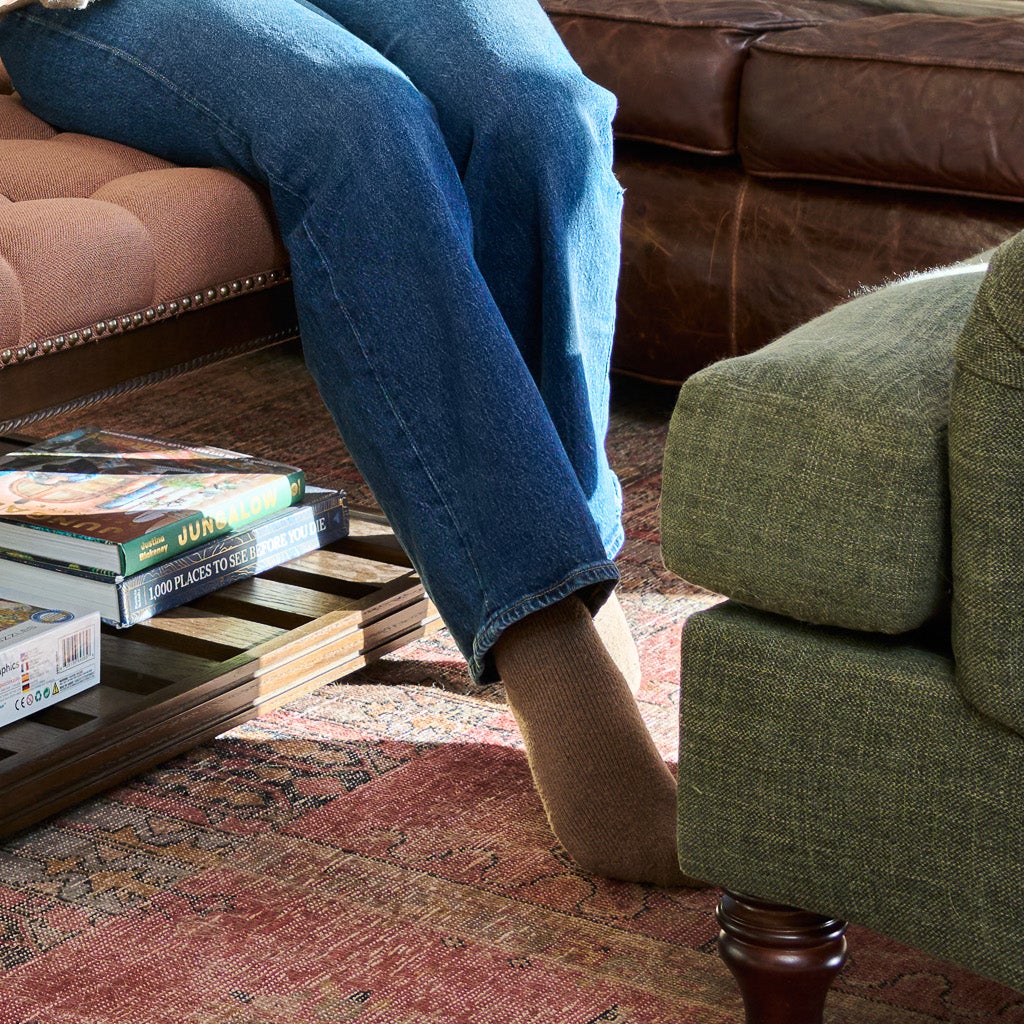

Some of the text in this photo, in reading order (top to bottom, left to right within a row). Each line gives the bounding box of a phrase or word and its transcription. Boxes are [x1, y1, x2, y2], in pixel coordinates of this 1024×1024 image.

[140, 535, 165, 550] Justina
[177, 487, 278, 547] JUNGALOW
[148, 578, 173, 601] 1,000
[174, 561, 213, 590] PLACES
[212, 556, 228, 575] TO
[229, 549, 249, 569] SEE
[250, 534, 288, 560] BEFORE
[287, 526, 309, 546] YOU
[308, 517, 327, 537] DIE
